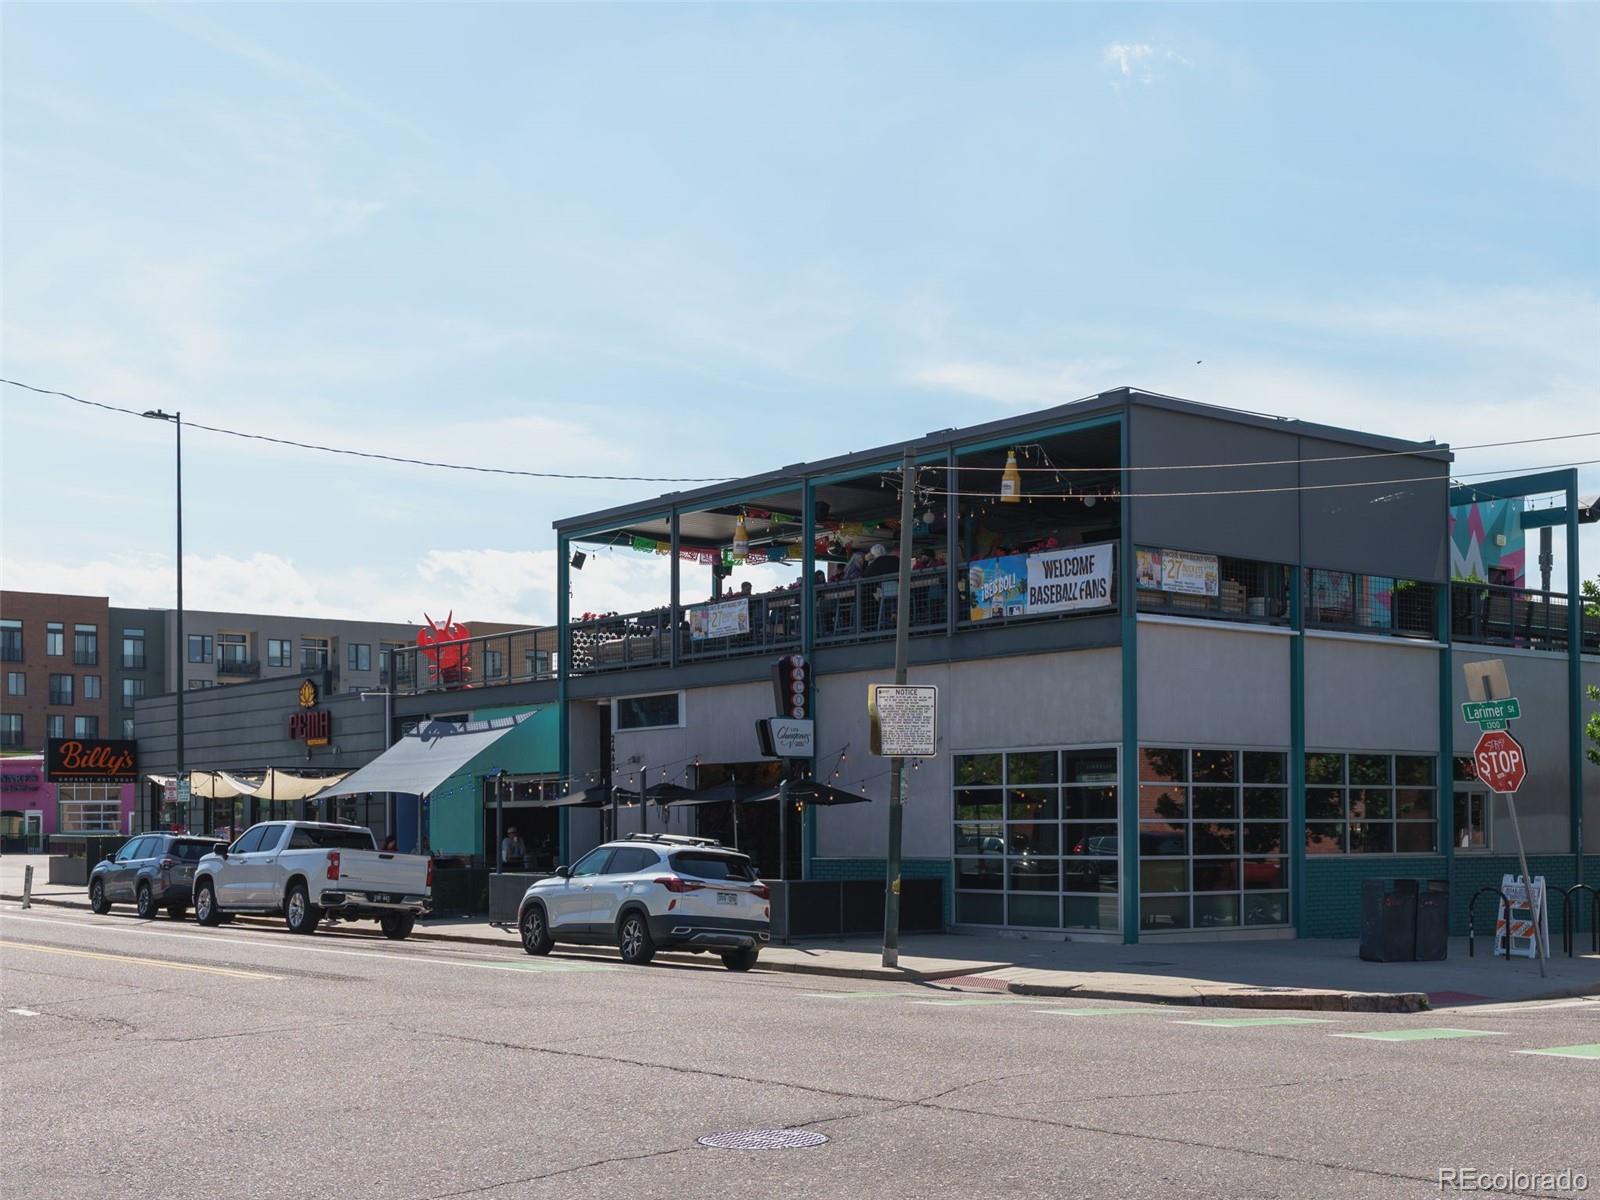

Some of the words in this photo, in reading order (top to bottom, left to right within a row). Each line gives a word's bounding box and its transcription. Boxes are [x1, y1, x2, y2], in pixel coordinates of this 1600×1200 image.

[1042, 555, 1095, 579] WELCOME
[1029, 582, 1078, 606] BASEBALL
[1080, 578, 1107, 600] FANS
[792, 655, 805, 720] TACOS
[1467, 704, 1504, 720] Larimer
[1507, 705, 1515, 713] St
[59, 741, 135, 775] Billy's
[1479, 751, 1519, 775] STOP
